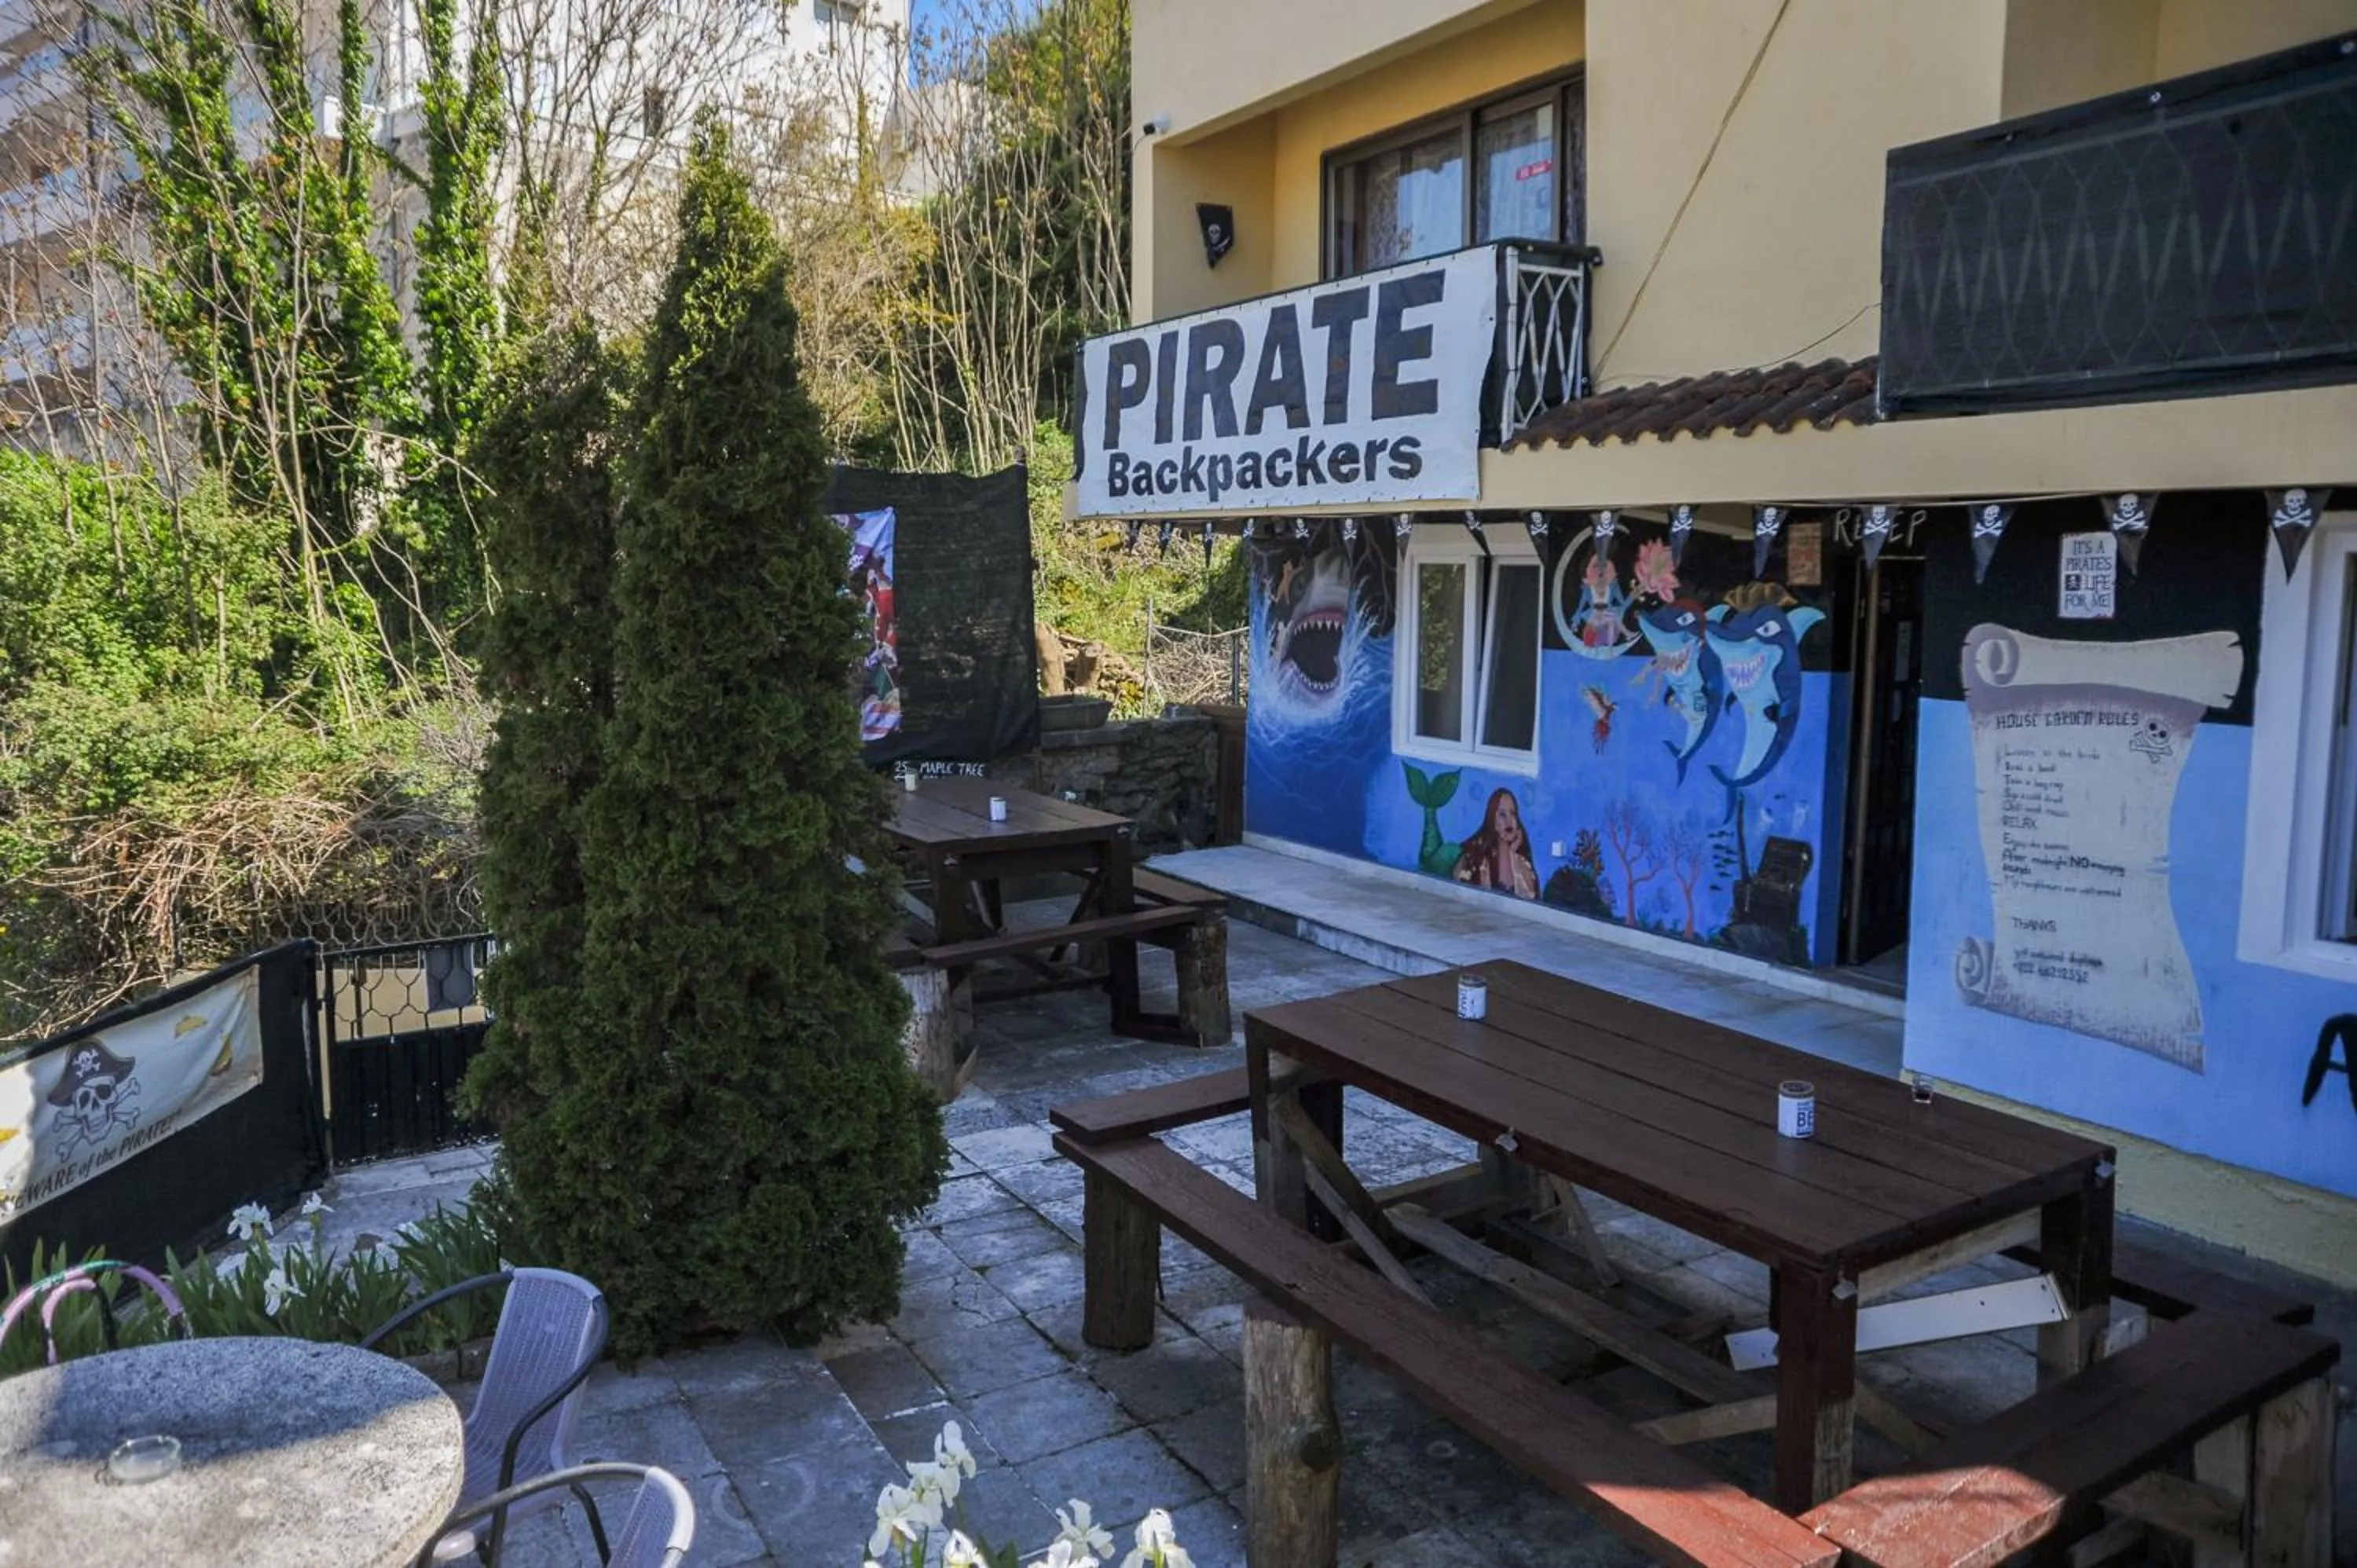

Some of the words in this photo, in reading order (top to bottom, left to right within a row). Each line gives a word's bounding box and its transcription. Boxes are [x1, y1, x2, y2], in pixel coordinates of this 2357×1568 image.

[1103, 269, 1446, 450] PIRATE
[1108, 434, 1423, 502] Backpackers
[2096, 540, 2105, 554] A
[1996, 714, 2037, 729] HOUSE
[2099, 712, 2139, 727] RULES
[919, 761, 954, 774] MAPLE
[958, 763, 985, 778] TREE
[2070, 855, 2090, 868] NO
[79, 1152, 95, 1178] of
[96, 1145, 117, 1167] the
